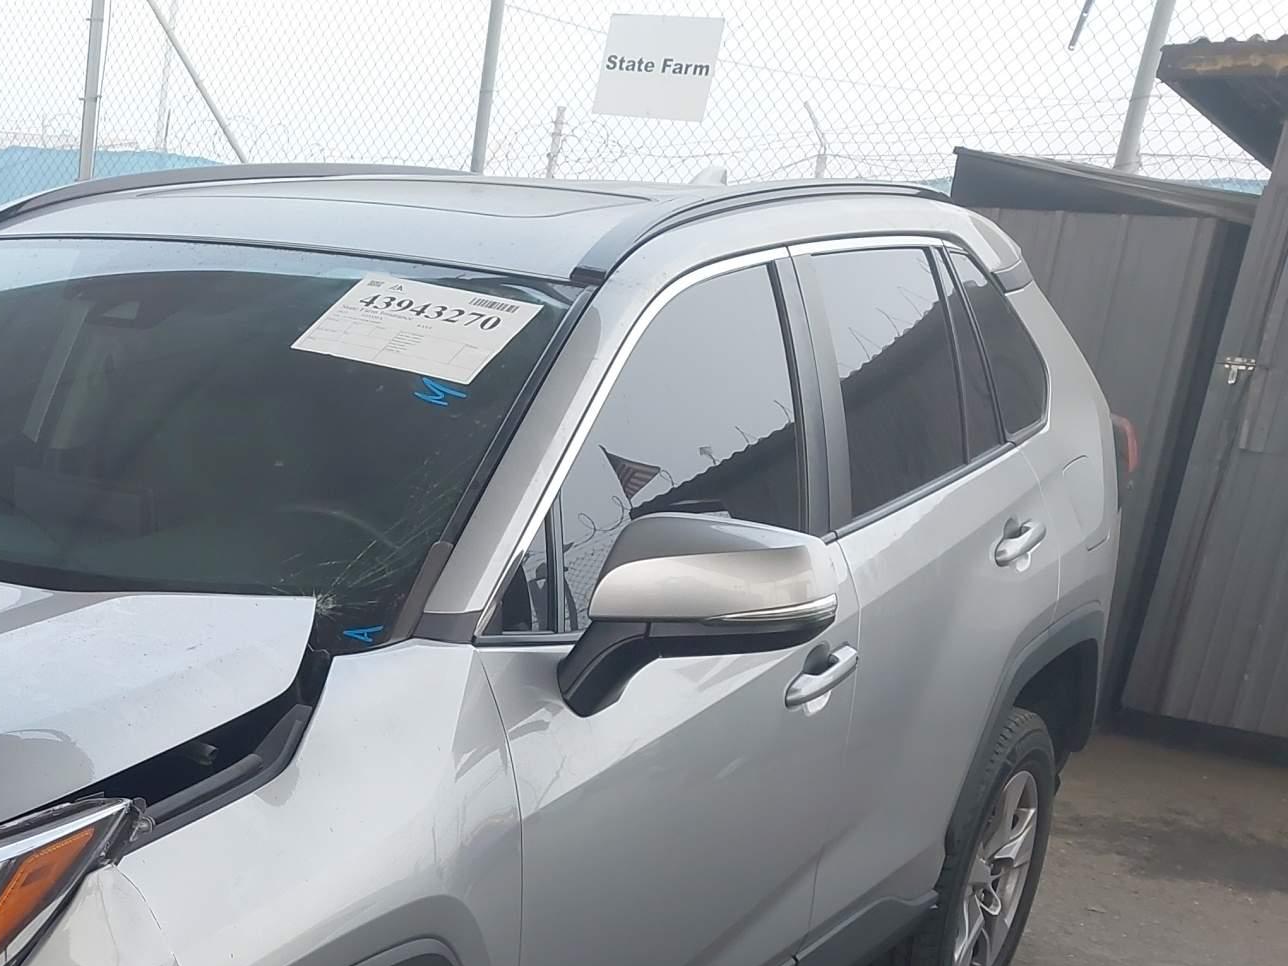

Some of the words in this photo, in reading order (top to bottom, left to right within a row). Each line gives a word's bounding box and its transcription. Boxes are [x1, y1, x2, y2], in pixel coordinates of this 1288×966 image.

[606, 54, 655, 73] State
[661, 58, 710, 76] Farm
[359, 294, 502, 331] 43943270
